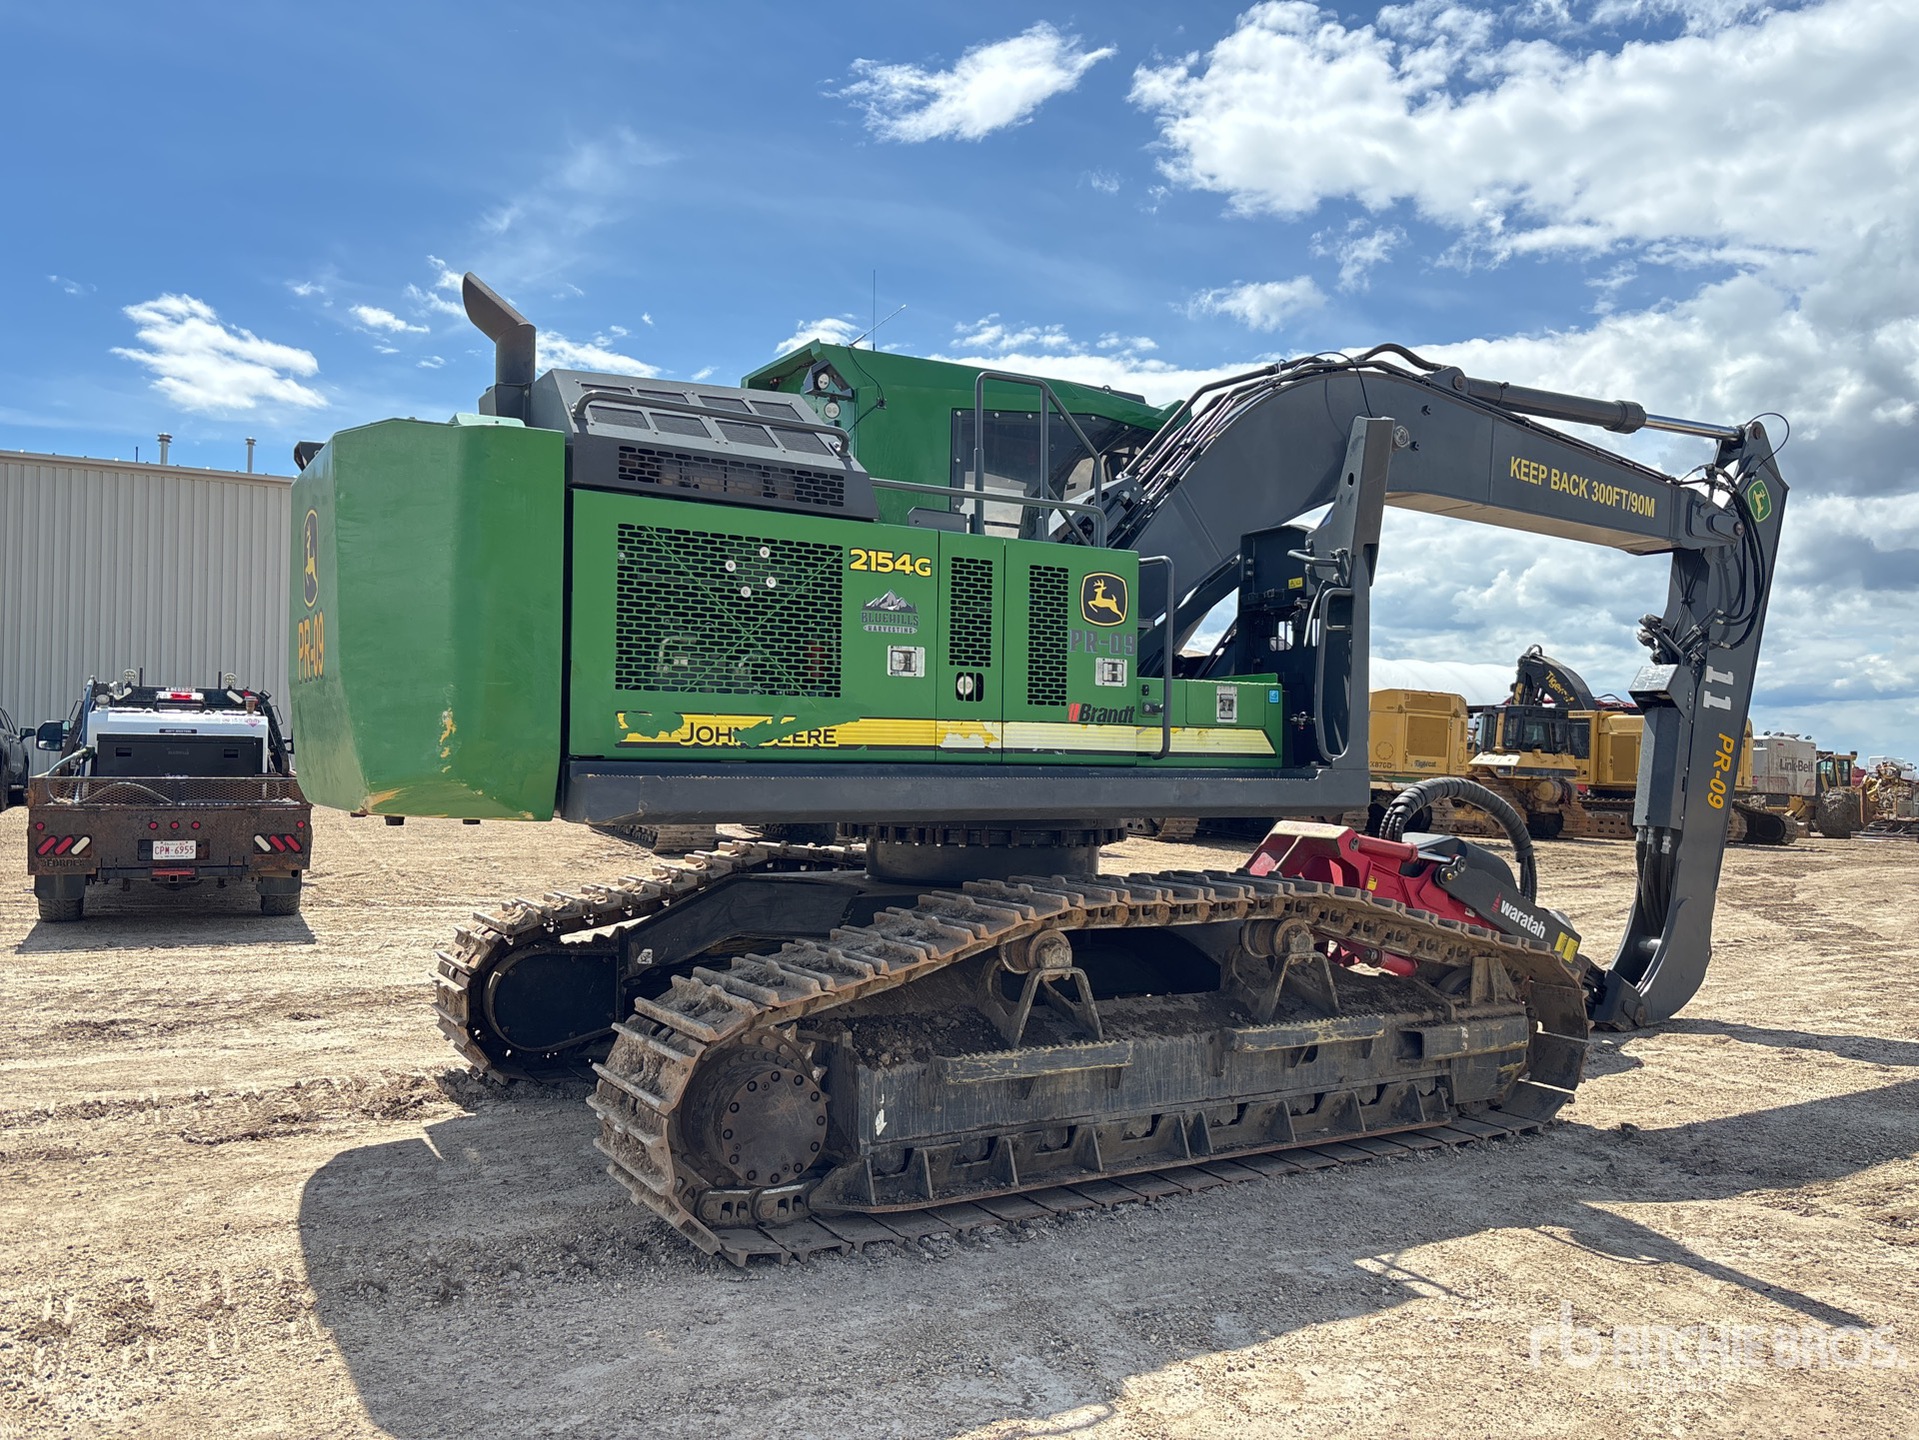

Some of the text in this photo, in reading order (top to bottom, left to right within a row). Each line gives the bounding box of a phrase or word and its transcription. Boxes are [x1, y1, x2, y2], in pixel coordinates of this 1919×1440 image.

[1510, 456, 1656, 518] KEEP BACK 300FT/90M
[849, 548, 932, 577] 2154G
[861, 611, 919, 627] BLUEHILLS
[297, 608, 325, 684] PR-09
[1069, 629, 1136, 656] PR-09
[1703, 665, 1734, 711] 11
[1079, 703, 1136, 723] Brandt
[1707, 733, 1735, 809] PR-09
[1500, 900, 1547, 939] waratah
